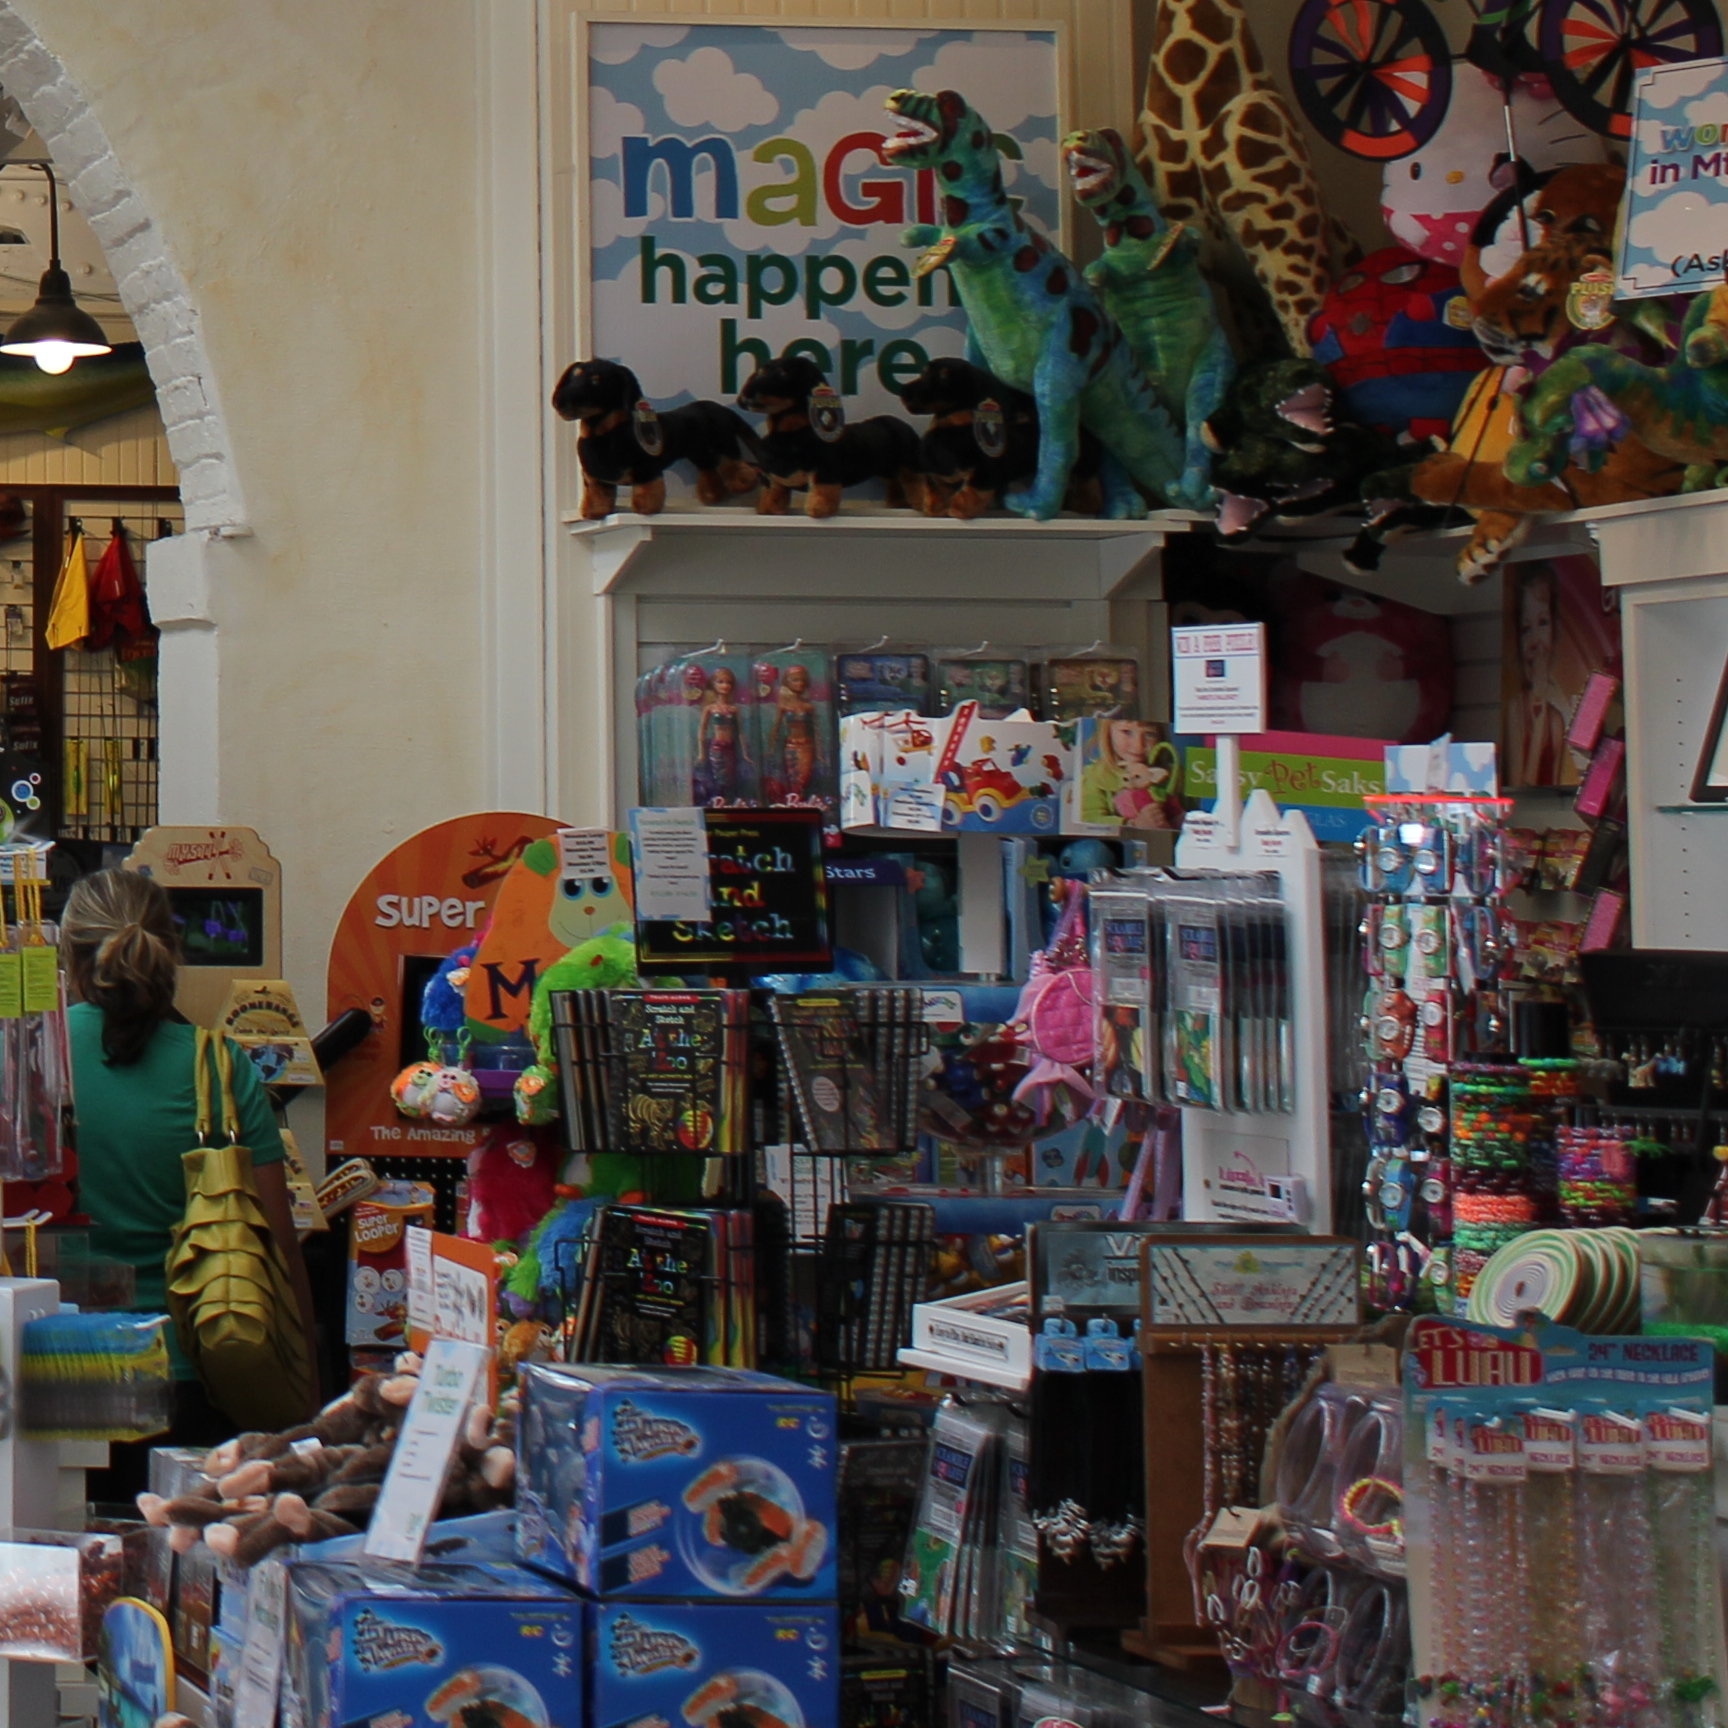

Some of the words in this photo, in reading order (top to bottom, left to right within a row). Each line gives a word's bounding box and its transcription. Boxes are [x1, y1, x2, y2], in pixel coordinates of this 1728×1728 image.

[1649, 158, 1681, 185] in
[640, 235, 964, 320] happen
[1189, 759, 1260, 787] Sasy
[1263, 758, 1321, 794] Pet
[1320, 770, 1381, 795] Saks
[711, 880, 768, 908] nd
[369, 1124, 402, 1141] The
[407, 1126, 477, 1145] Amazing
[1417, 1327, 1466, 1349] ET'S
[1622, 1342, 1700, 1362] NECKLACE
[1431, 1349, 1533, 1387] LUAU
